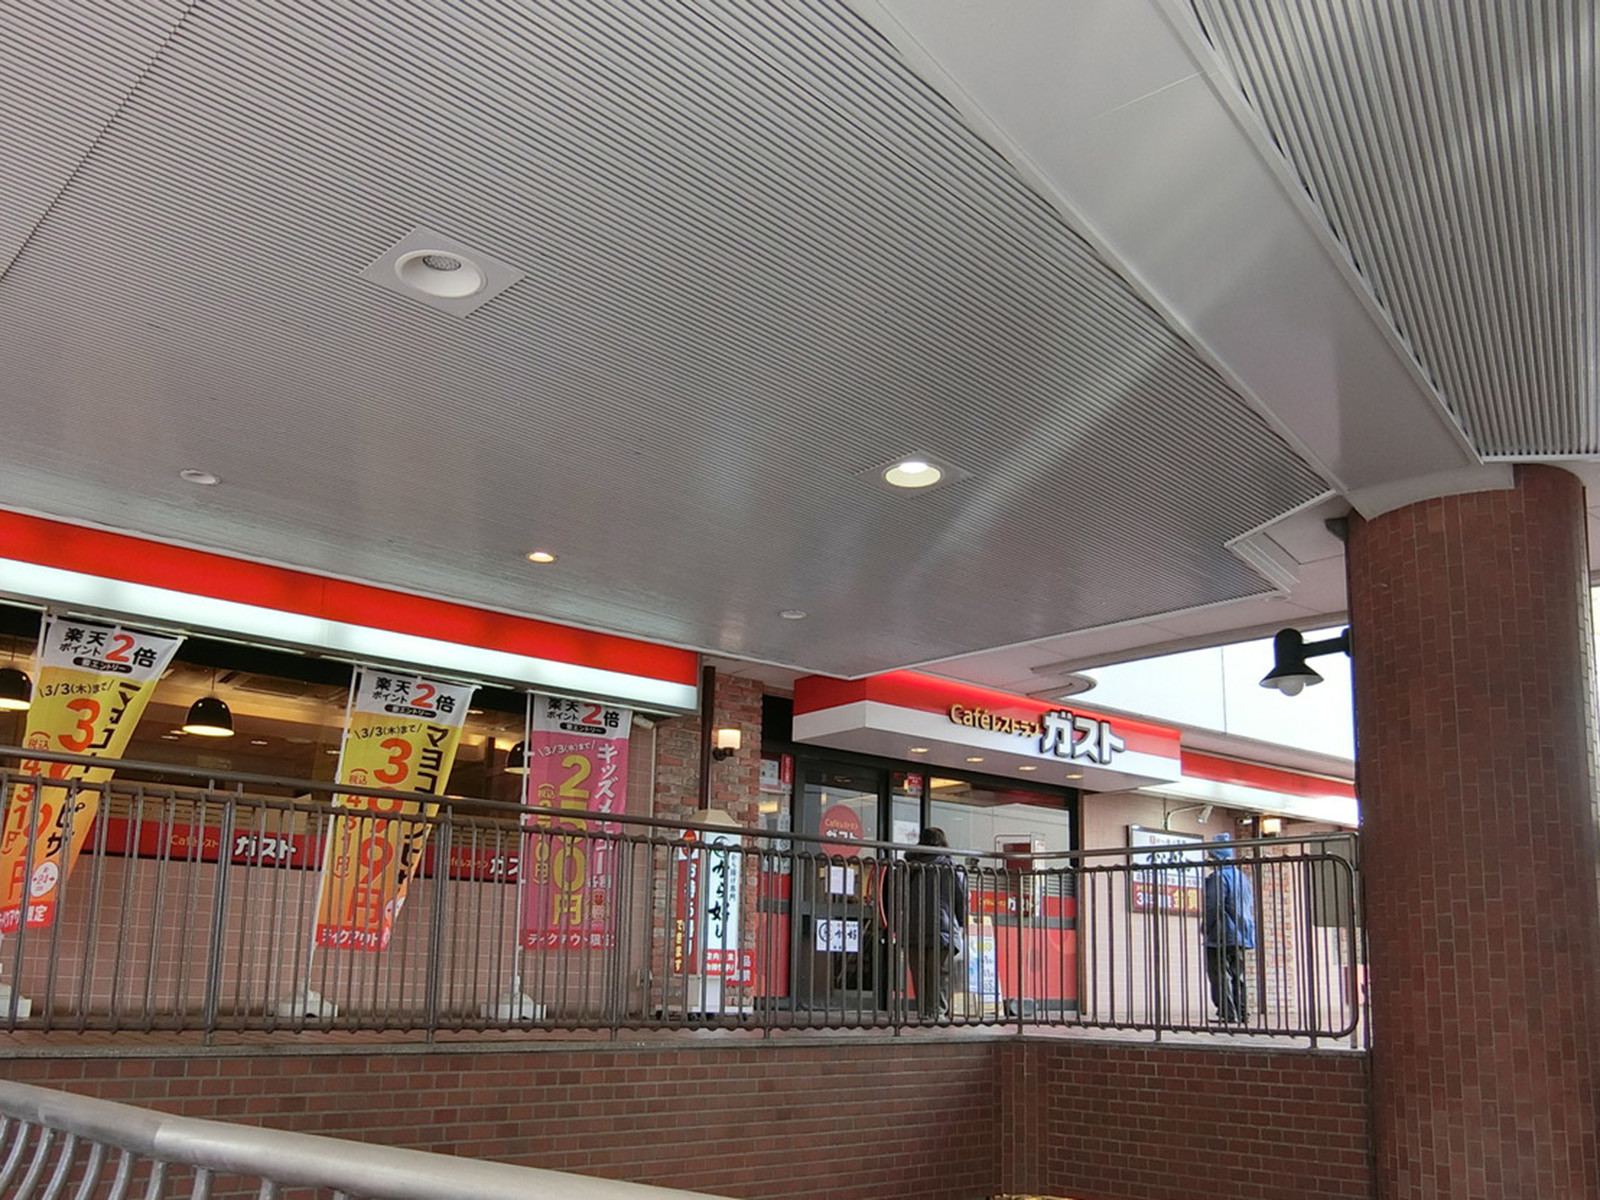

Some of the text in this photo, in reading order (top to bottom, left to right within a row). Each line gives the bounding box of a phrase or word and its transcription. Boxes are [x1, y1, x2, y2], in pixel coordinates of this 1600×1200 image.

[64, 627, 108, 647] 楽天
[59, 642, 102, 657] ポイント
[375, 676, 412, 696] 楽天
[372, 691, 408, 704] ポイント
[546, 711, 579, 722] ポイント
[951, 703, 1040, 738] Caféレストラン
[1039, 709, 1126, 764] ガスト
[234, 836, 297, 859] ガスト
[489, 855, 519, 876] ガス
